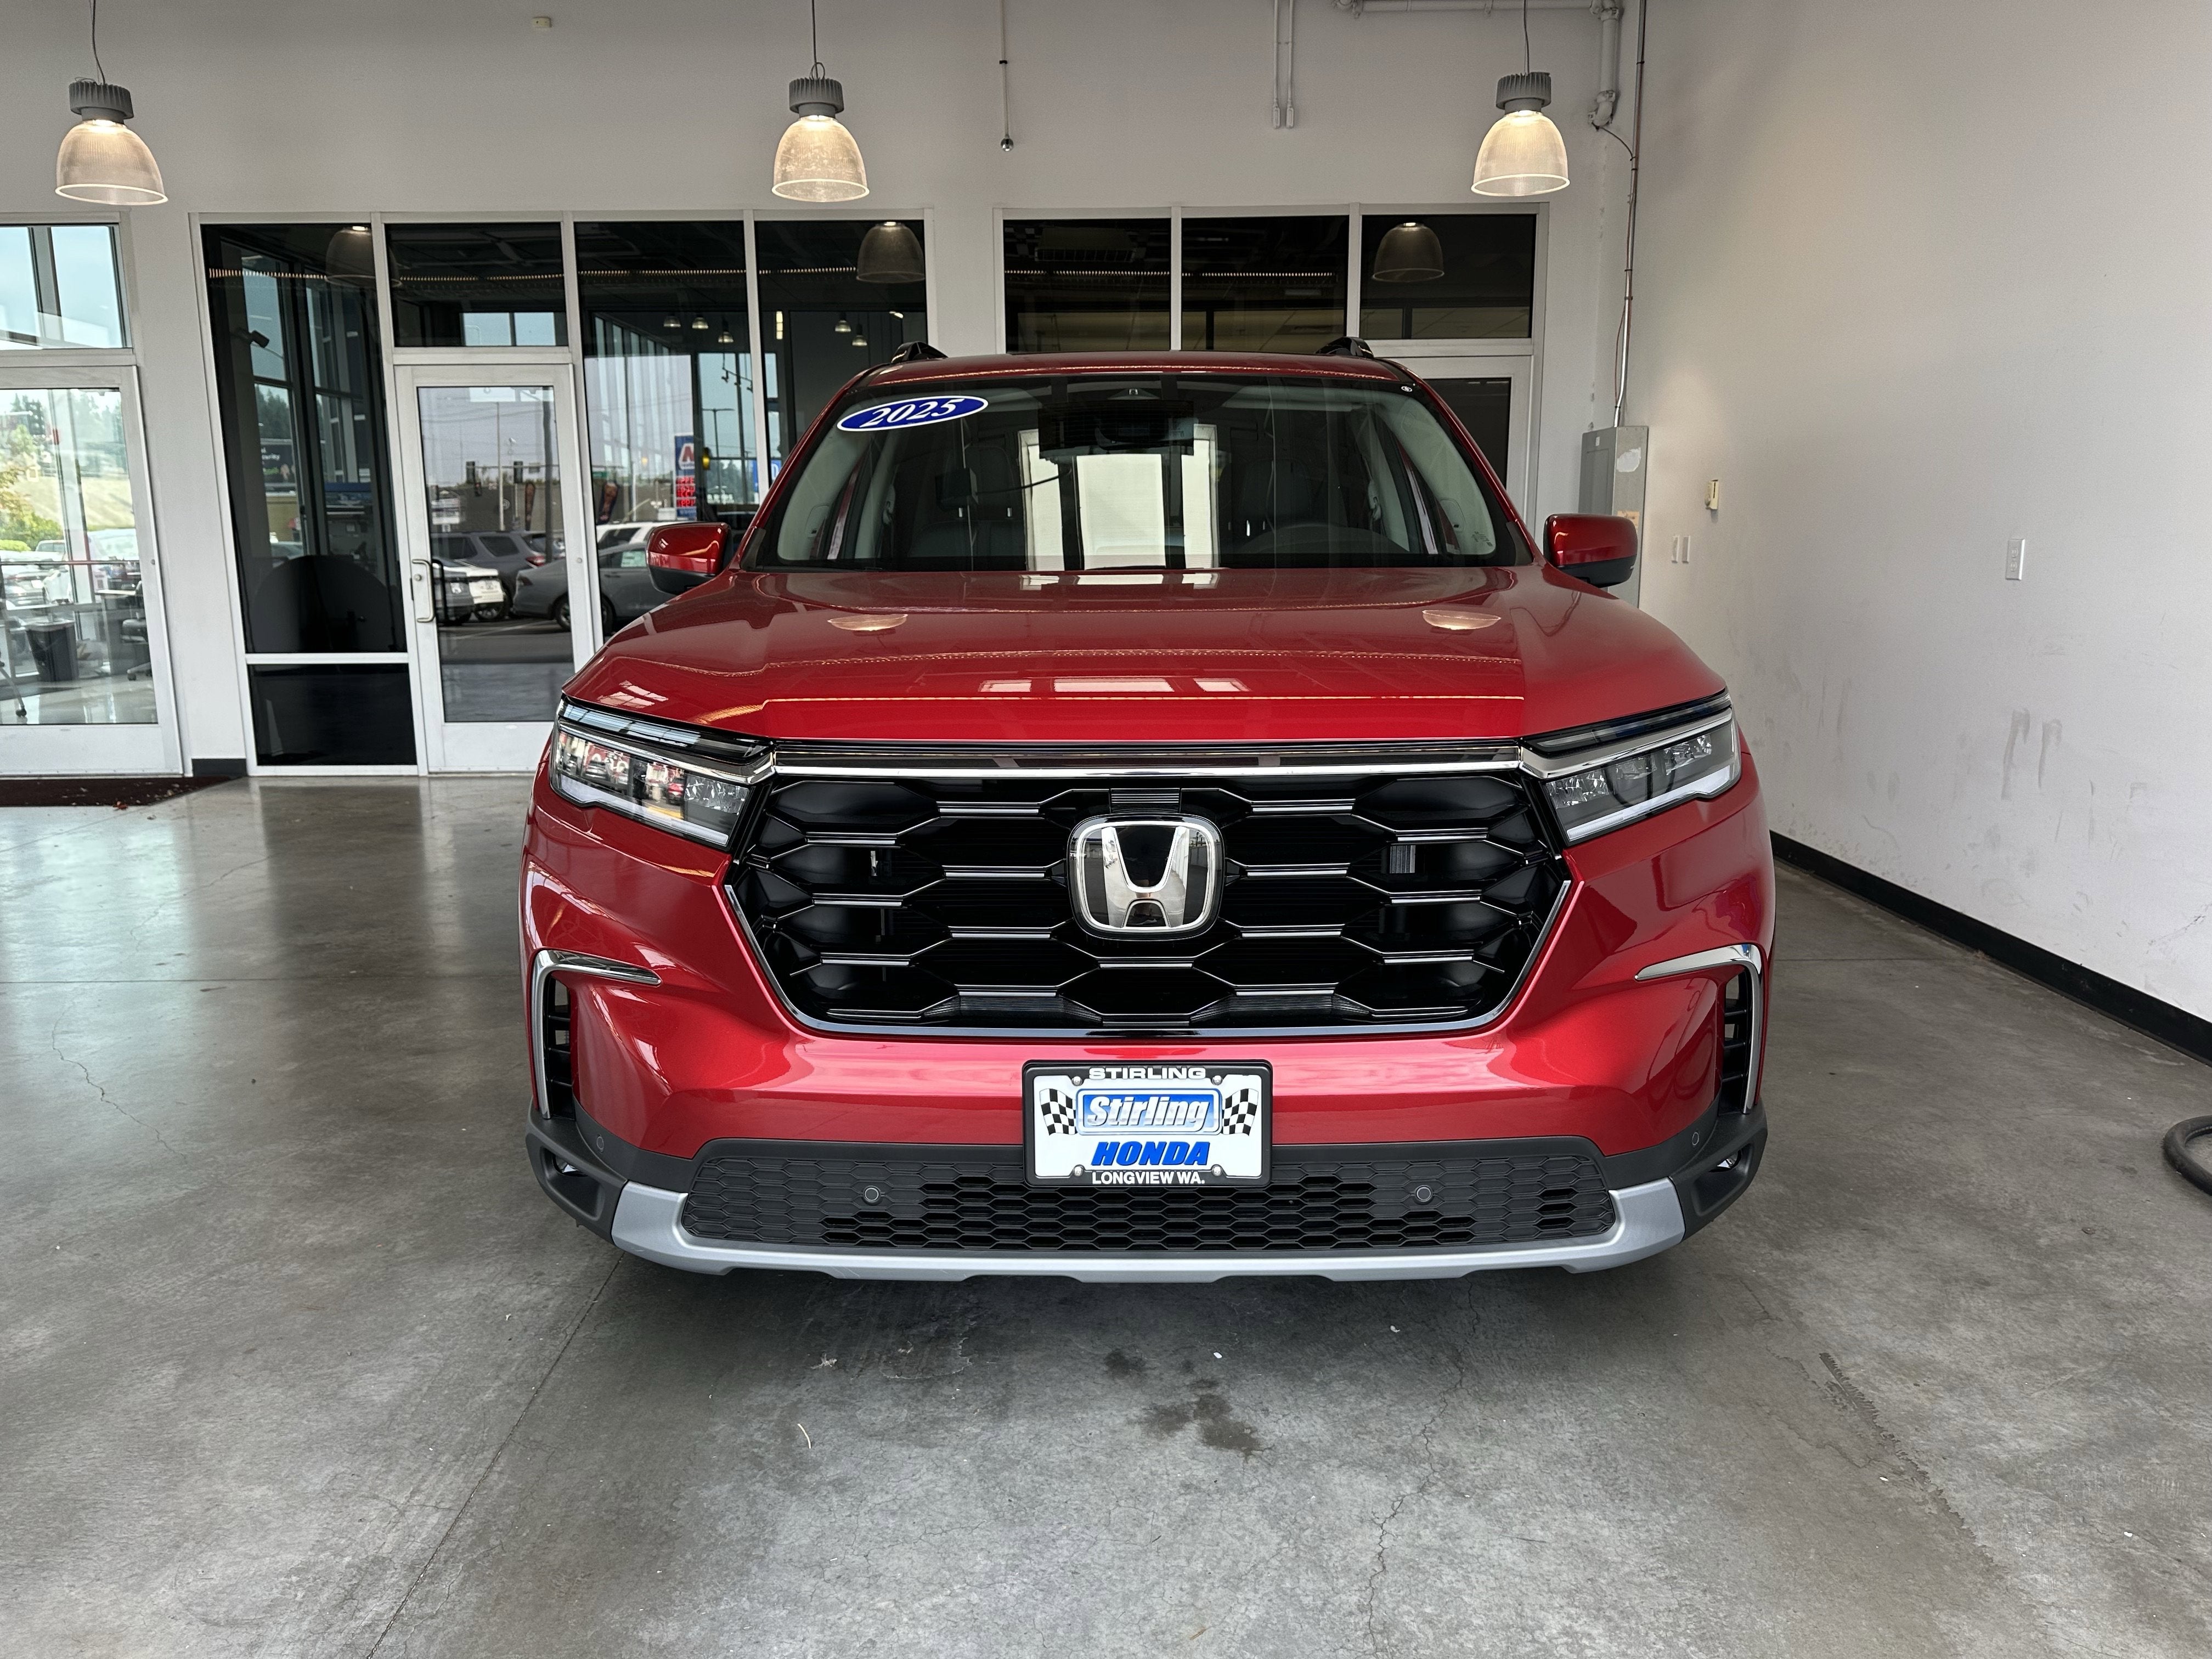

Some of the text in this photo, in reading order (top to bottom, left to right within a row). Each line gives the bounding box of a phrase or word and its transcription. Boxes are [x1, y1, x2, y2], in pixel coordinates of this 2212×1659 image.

[859, 398, 964, 427] 2025
[1089, 1068, 1206, 1079] STIRLING
[1088, 1096, 1209, 1132] Stirling
[1091, 1141, 1210, 1166] HONDA
[1092, 1172, 1205, 1184] LONGVIEW WA.
